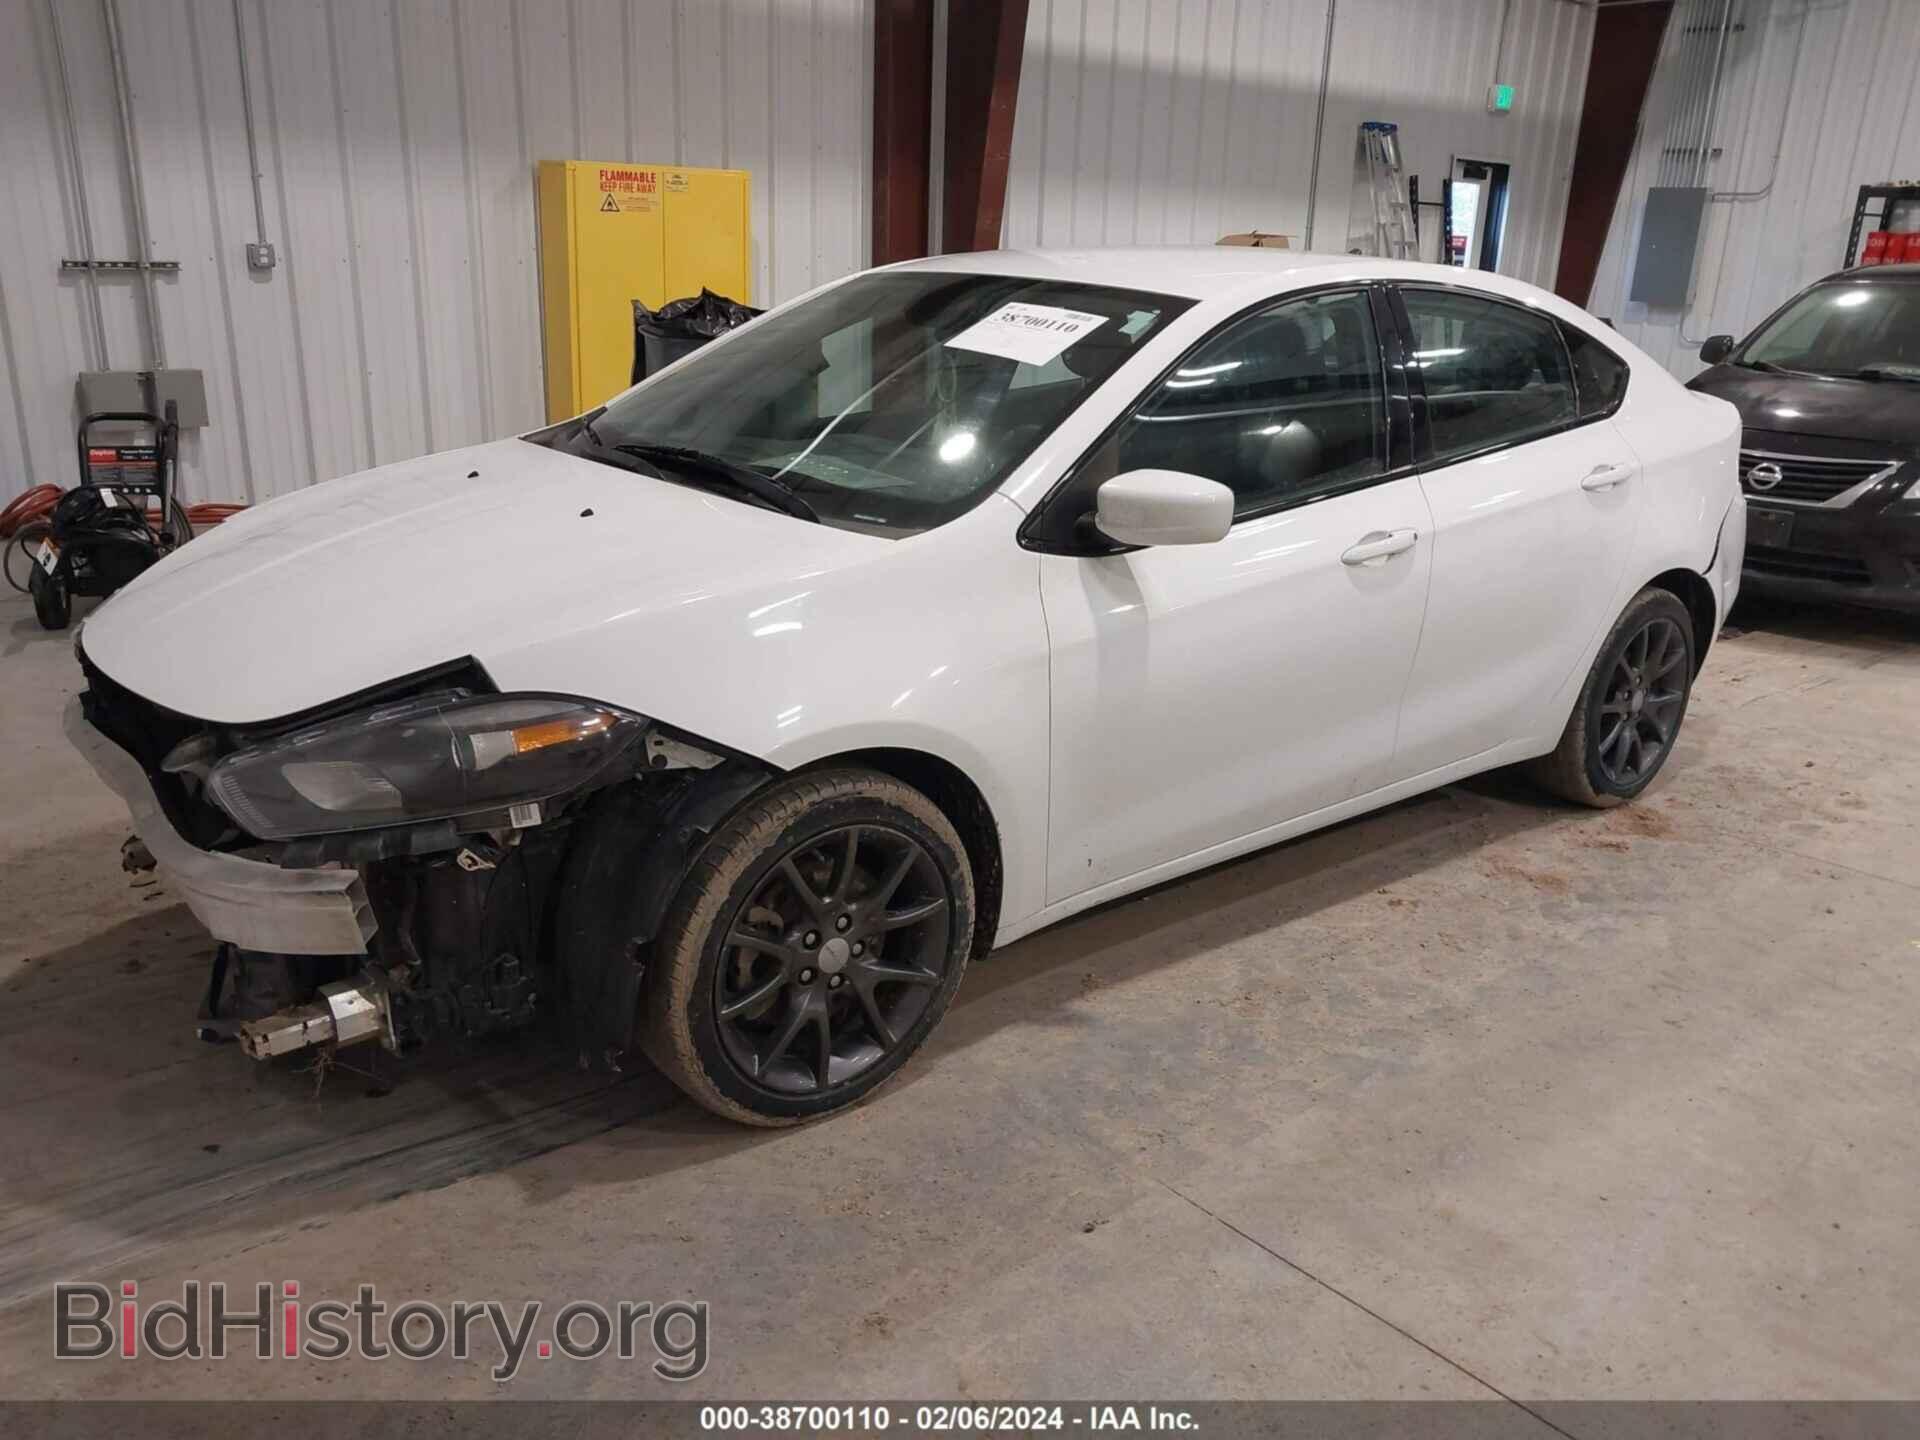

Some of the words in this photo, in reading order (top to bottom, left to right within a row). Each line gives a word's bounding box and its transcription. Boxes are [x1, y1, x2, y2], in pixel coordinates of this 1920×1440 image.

[599, 169, 656, 183] FLAMMABLE
[600, 181, 617, 192] KEEP
[619, 182, 635, 193] FIRE
[637, 183, 656, 193] AWAY
[1001, 313, 1080, 333] 38700110
